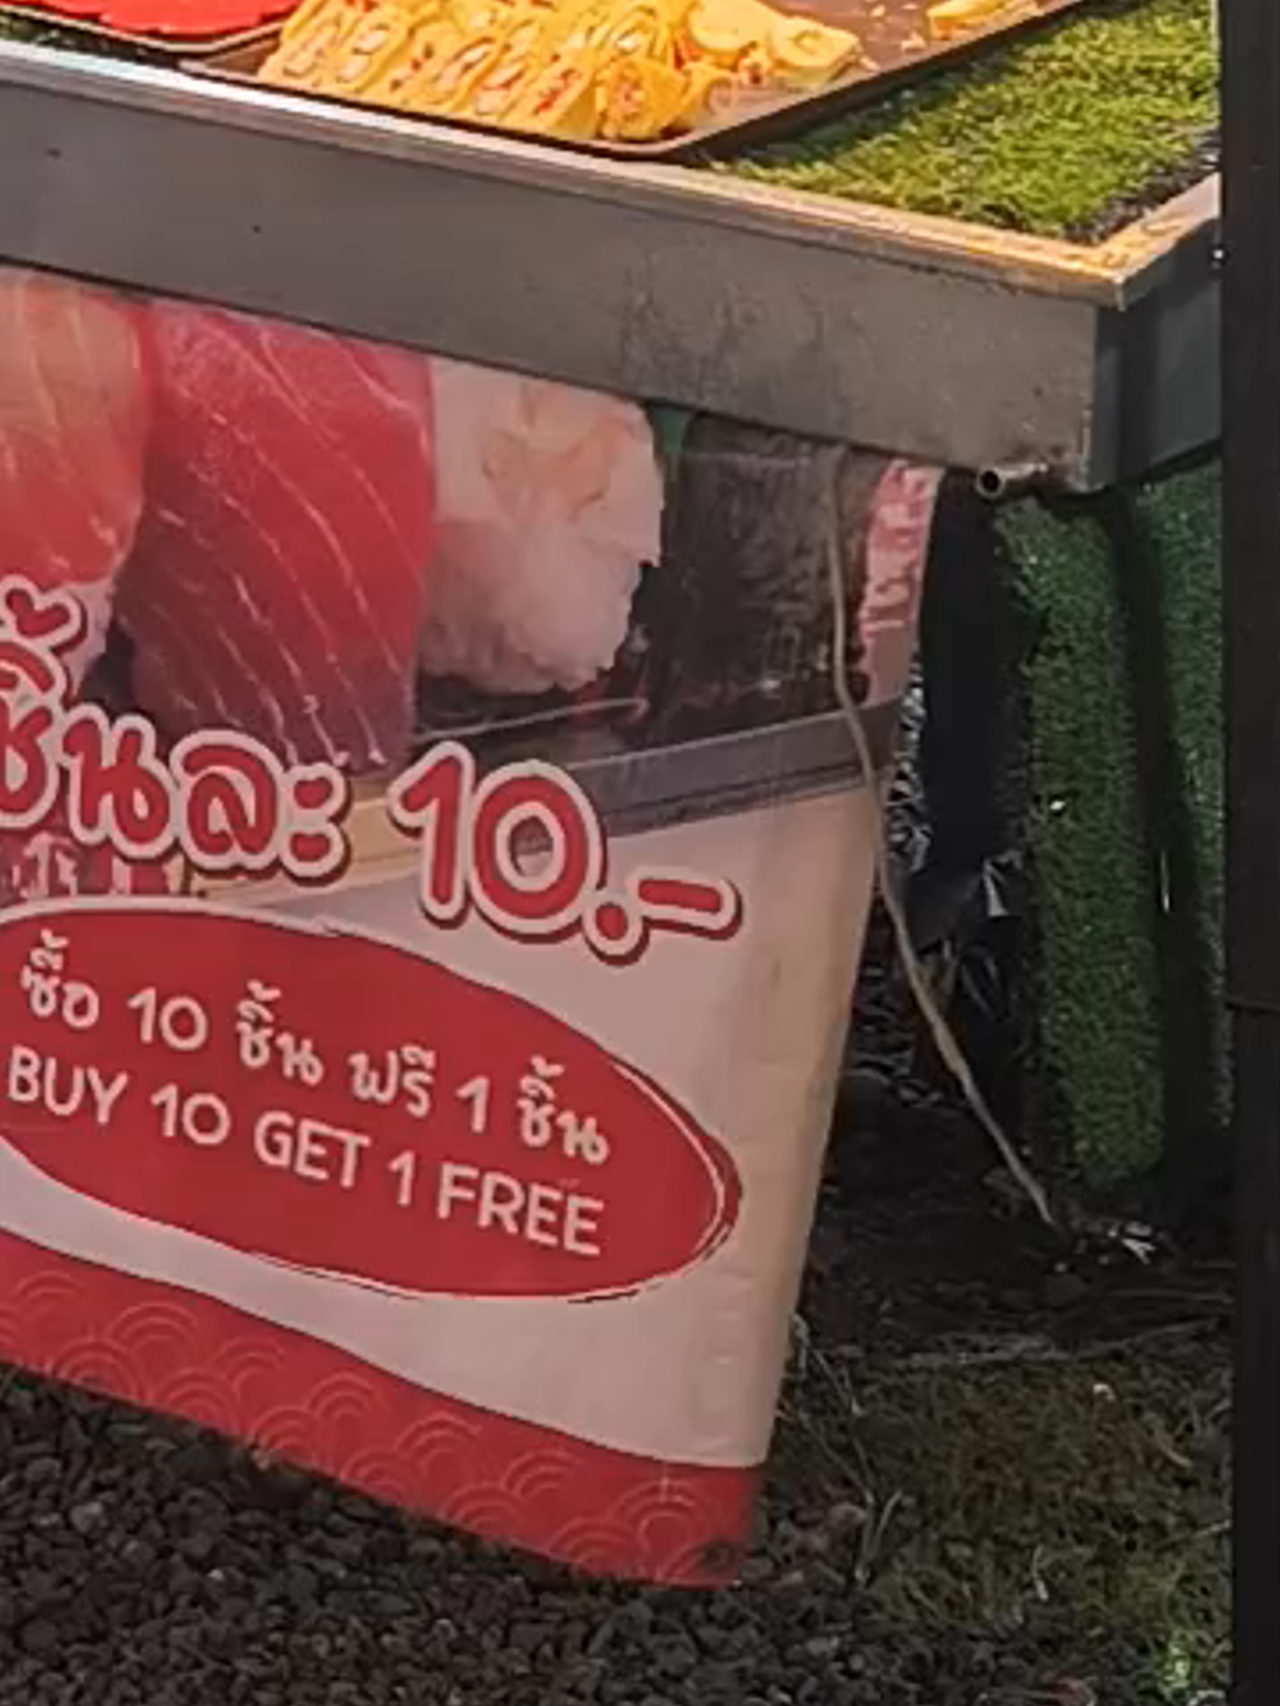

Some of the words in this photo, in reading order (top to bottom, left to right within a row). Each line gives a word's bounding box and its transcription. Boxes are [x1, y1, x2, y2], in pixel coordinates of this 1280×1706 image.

[391, 746, 731, 952] 10.-
[6, 1045, 129, 1125] BUY
[149, 1082, 232, 1146] 10
[253, 1110, 371, 1189] GET
[387, 1150, 417, 1207] 1
[436, 1162, 605, 1257] FREE
[126, 986, 208, 1051] 10
[235, 979, 324, 1086] ชิ้น
[348, 1043, 436, 1118] ฟรี
[455, 1075, 491, 1134] 1
[516, 1055, 610, 1165] ชิ้น
